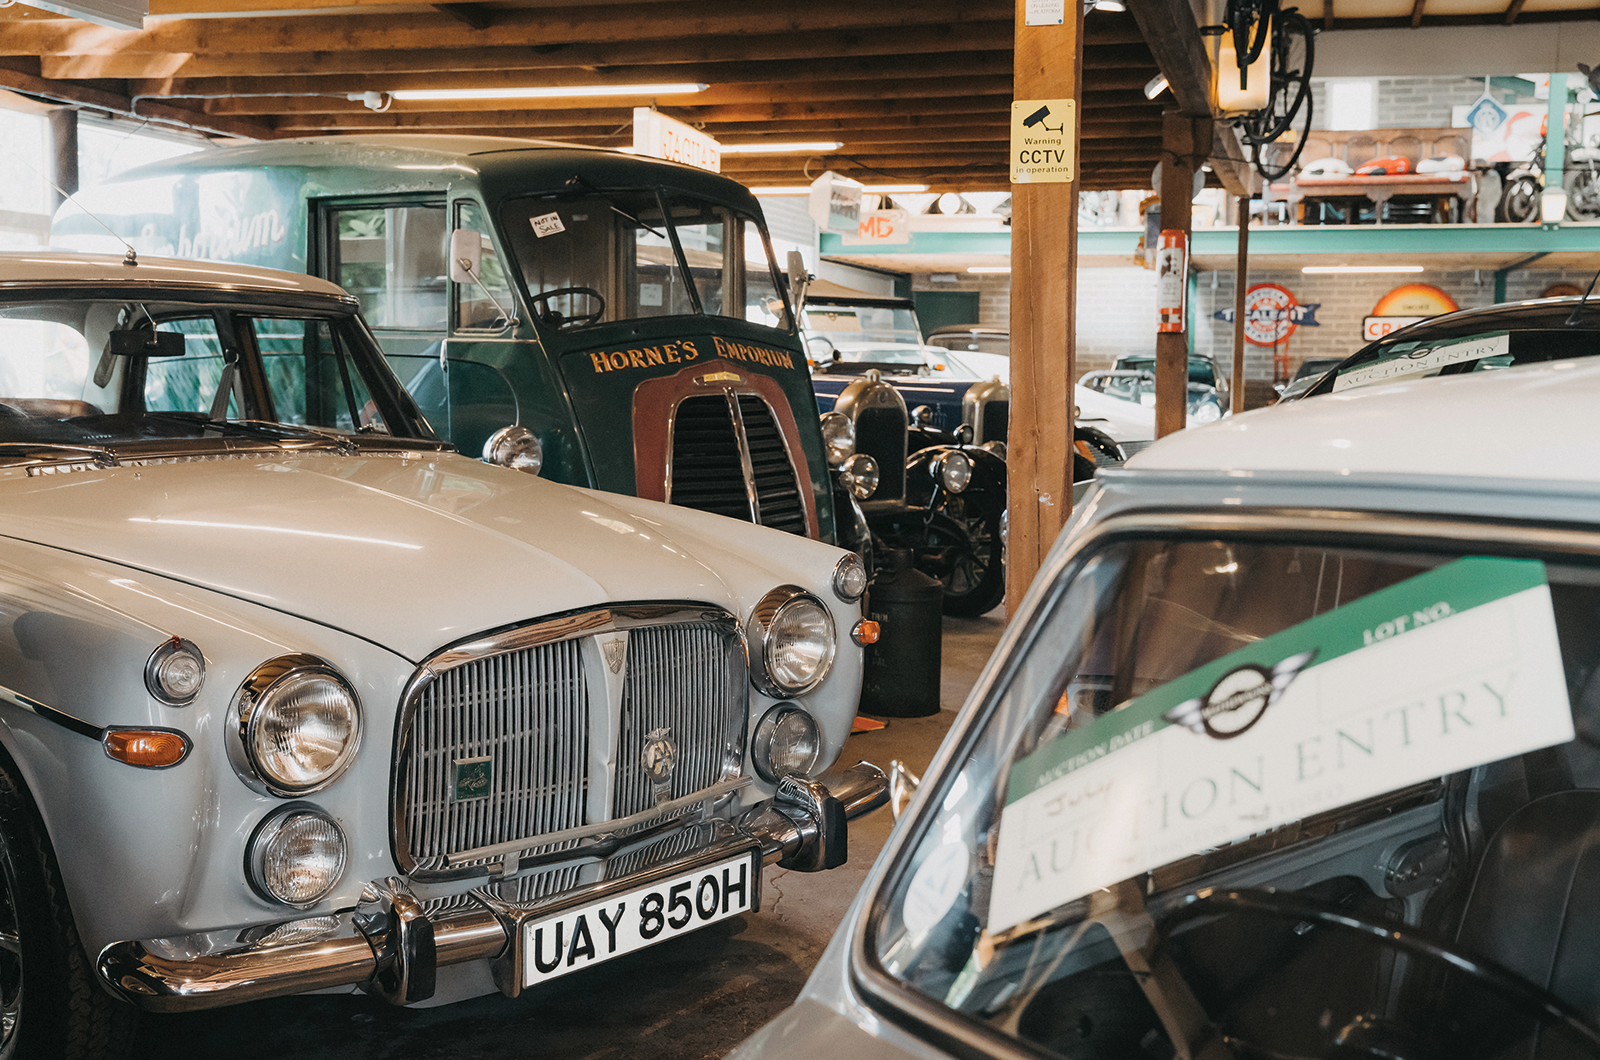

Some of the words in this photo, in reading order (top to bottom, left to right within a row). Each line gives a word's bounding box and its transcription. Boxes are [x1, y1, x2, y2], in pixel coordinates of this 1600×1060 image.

[1024, 137, 1062, 146] Warning
[1019, 149, 1066, 164] CCTV
[1026, 166, 1069, 174] operation
[534, 217, 549, 227] NOT
[539, 223, 560, 232] SALE
[858, 216, 894, 239] MG
[590, 340, 699, 373] HORNE'S
[1343, 359, 1428, 387] AUCTION
[1436, 345, 1498, 364] ENTRY
[1363, 614, 1410, 647] LOT
[1413, 601, 1457, 629] NO.
[1295, 671, 1519, 782] ENTRY
[1035, 742, 1107, 789] AUCTION
[1109, 720, 1155, 752] DATE
[534, 902, 626, 974] UAY
[639, 863, 747, 940] 850H
